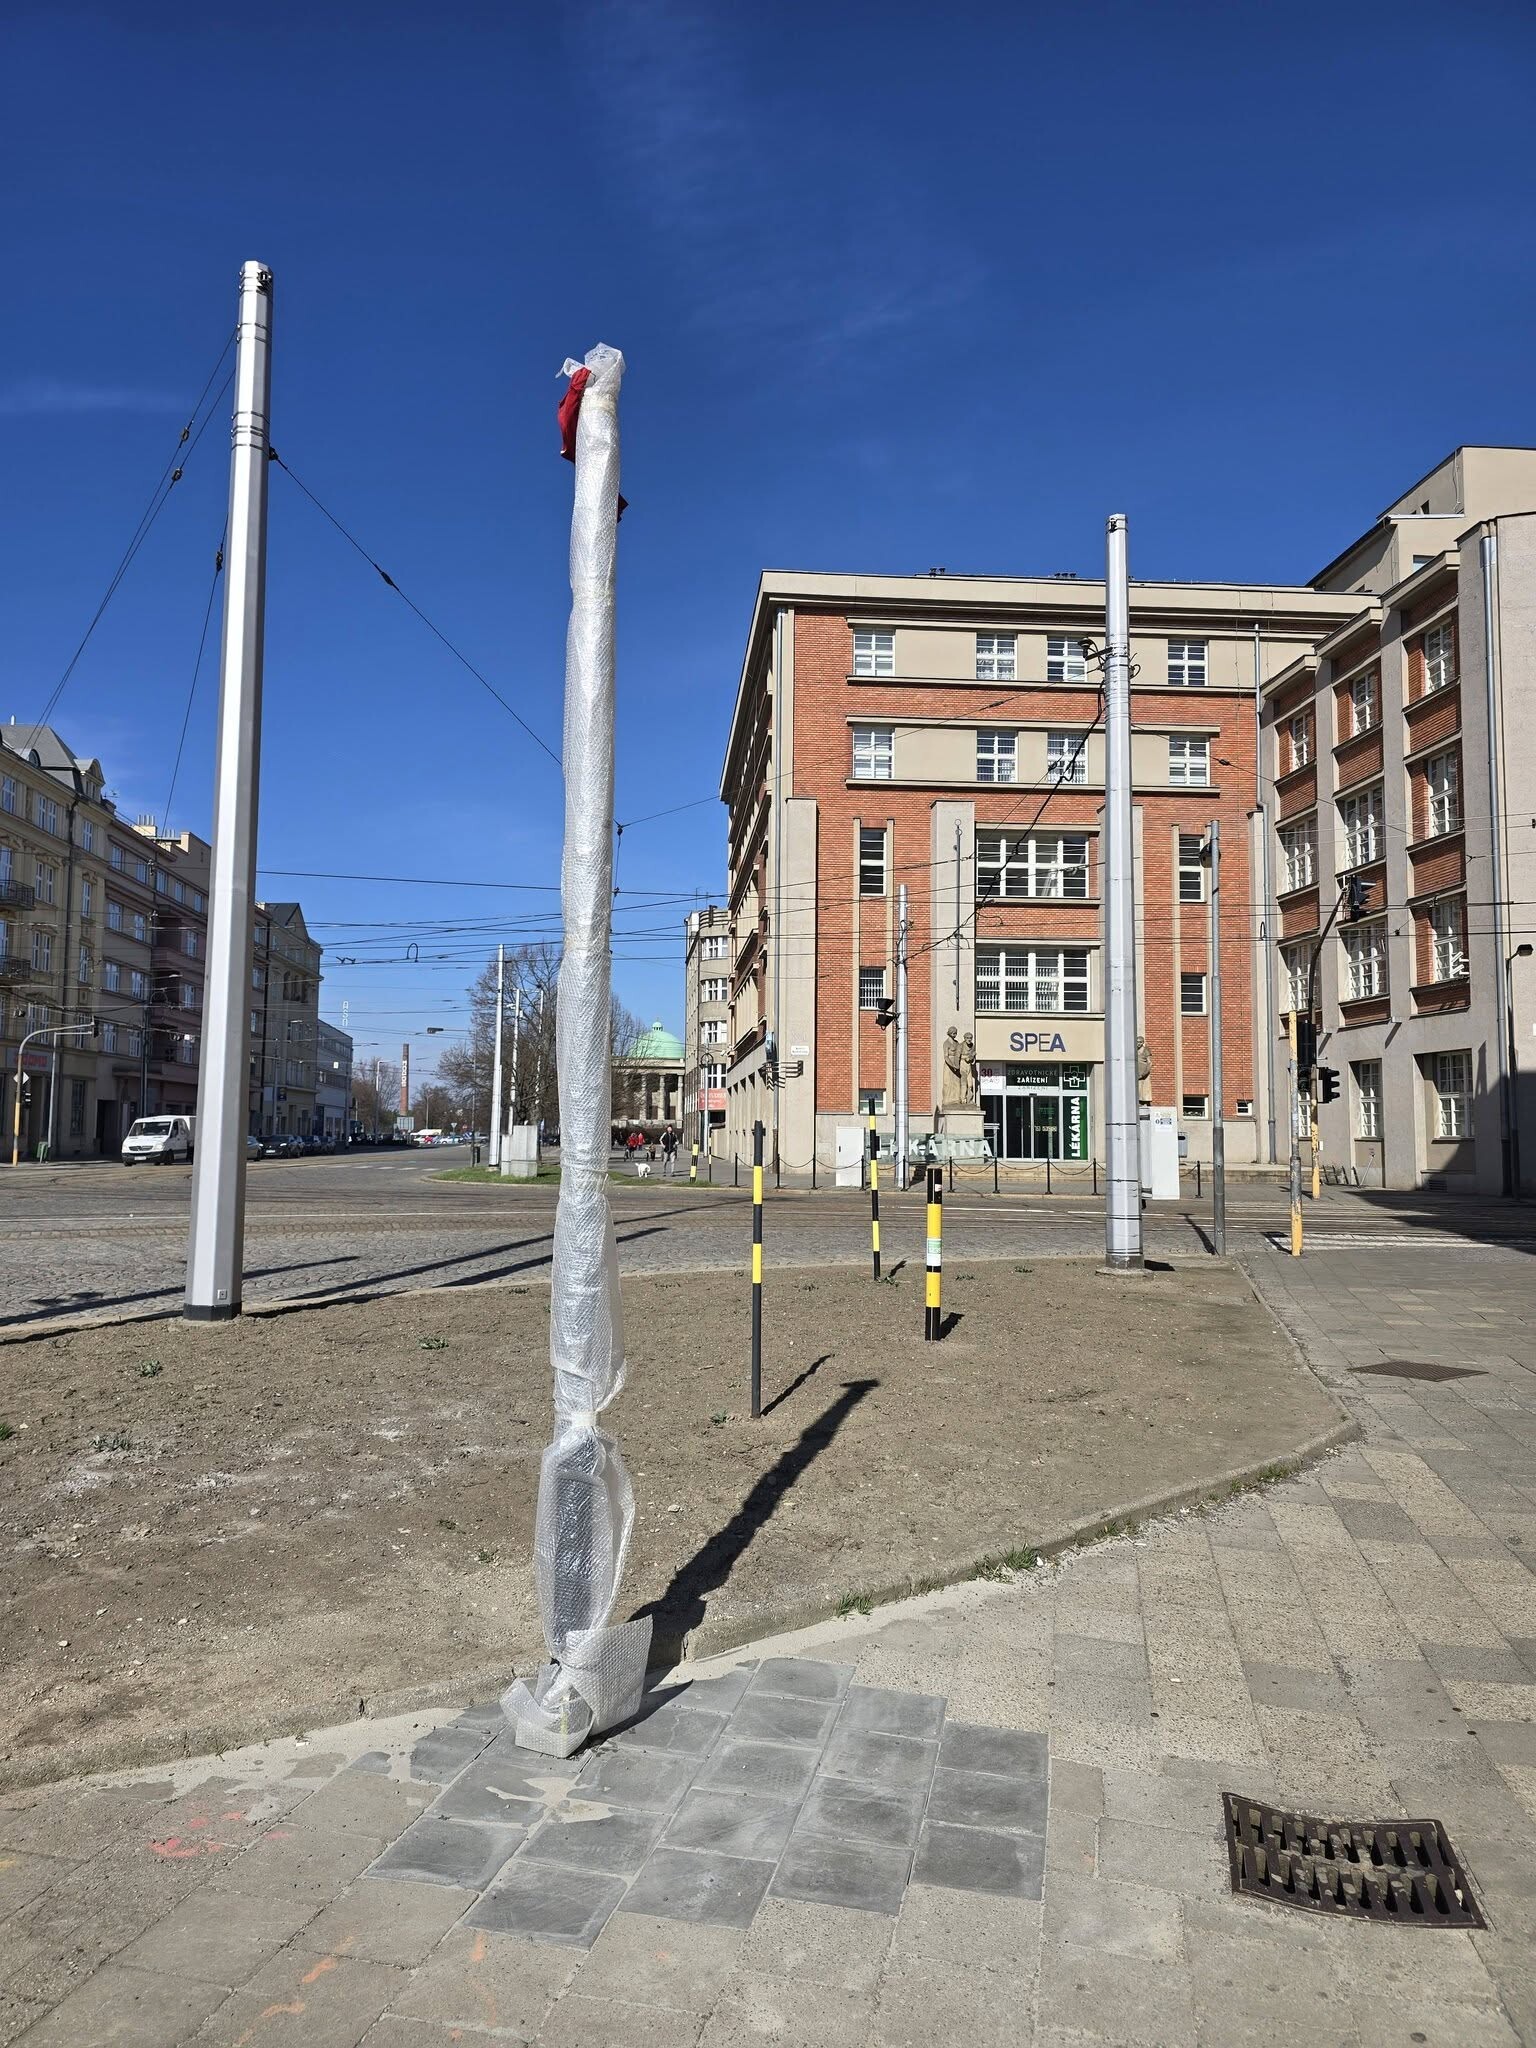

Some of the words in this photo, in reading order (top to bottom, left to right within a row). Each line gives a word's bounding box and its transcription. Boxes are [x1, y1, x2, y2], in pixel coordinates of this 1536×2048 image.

[1010, 1032, 1066, 1052] SPEA
[981, 1068, 993, 1077] 30
[1007, 1068, 1057, 1076] ZDRAVOTNICKÉ
[1016, 1076, 1049, 1084] ZAŘÍZENÍ
[1069, 1097, 1080, 1157] LÉKÁRNA
